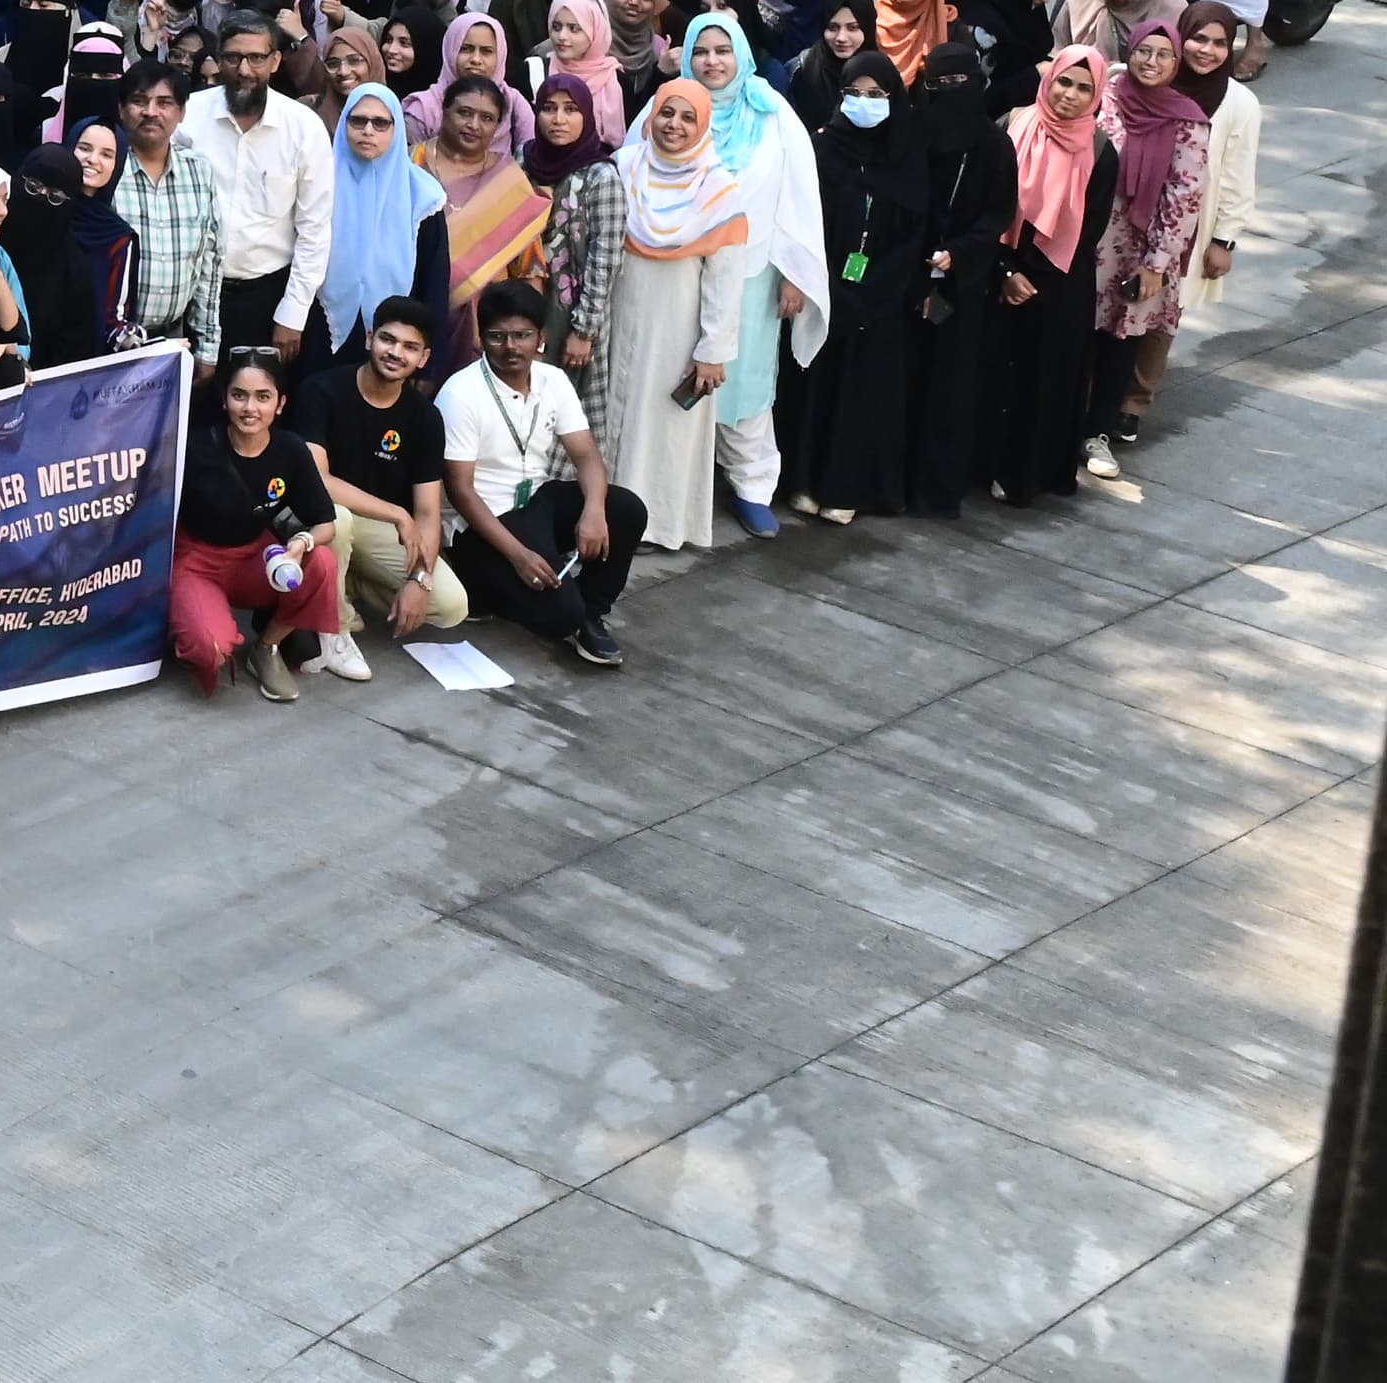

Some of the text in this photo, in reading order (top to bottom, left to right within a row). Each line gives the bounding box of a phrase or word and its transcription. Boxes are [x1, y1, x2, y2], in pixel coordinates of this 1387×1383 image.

[37, 448, 148, 498] MEETUP
[34, 511, 54, 535] TO
[58, 558, 143, 602] HYDERABAD
[38, 604, 90, 627] 2024
